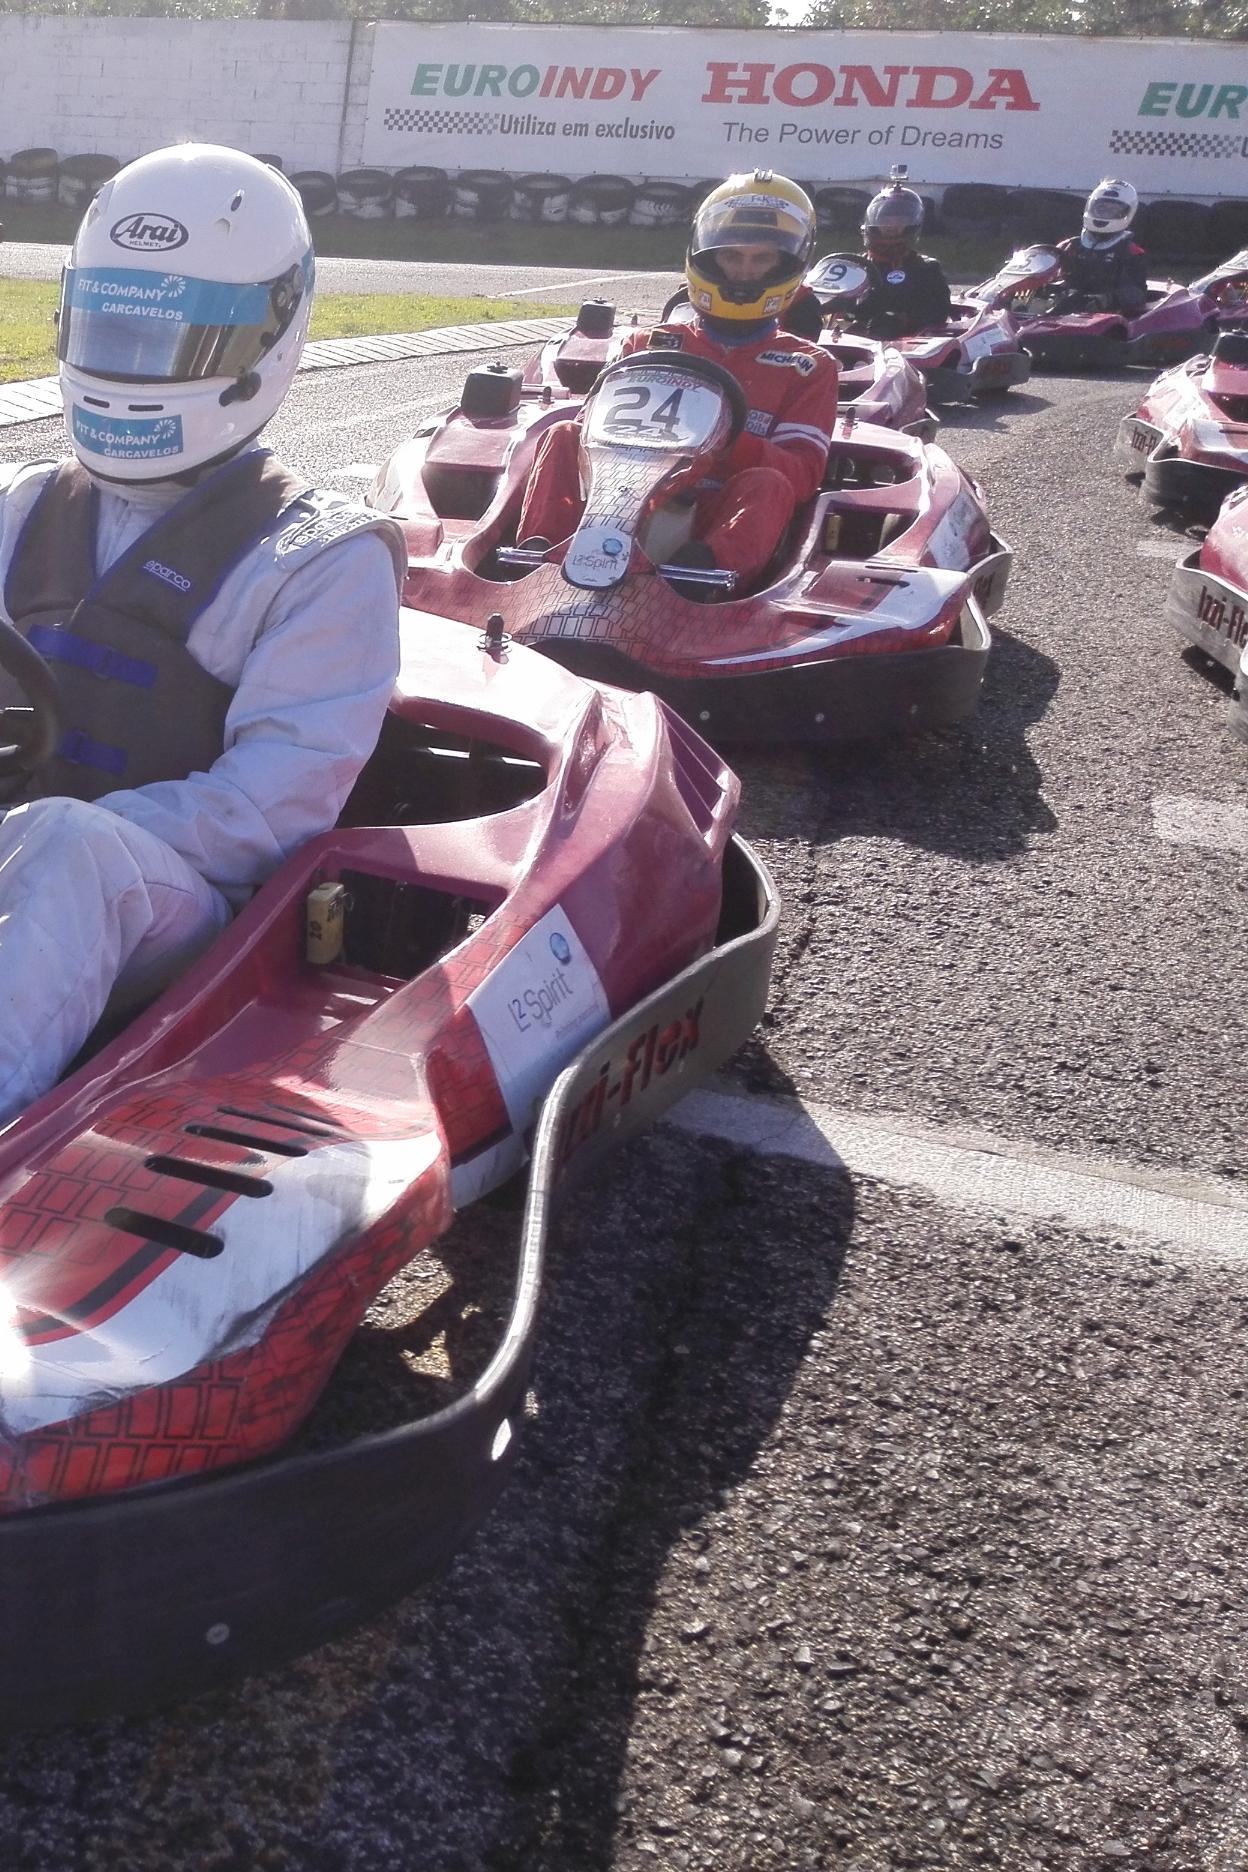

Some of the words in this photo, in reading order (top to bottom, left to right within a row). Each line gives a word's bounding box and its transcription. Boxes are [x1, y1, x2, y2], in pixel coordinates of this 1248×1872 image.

[410, 63, 662, 102] EUROINDY
[701, 61, 1041, 112] HONDA
[499, 113, 557, 137] Utiliza
[562, 120, 589, 138] em
[595, 117, 676, 141] exclusivo
[721, 121, 770, 144] The
[778, 122, 861, 146] Power
[868, 124, 896, 146] of
[900, 125, 1005, 150] Dreams
[121, 216, 180, 243] Arai
[101, 302, 184, 320] CARCAVELOS
[760, 352, 813, 372] MICHELIN
[602, 385, 684, 434] 24
[104, 445, 179, 459] CARCAVELOS
